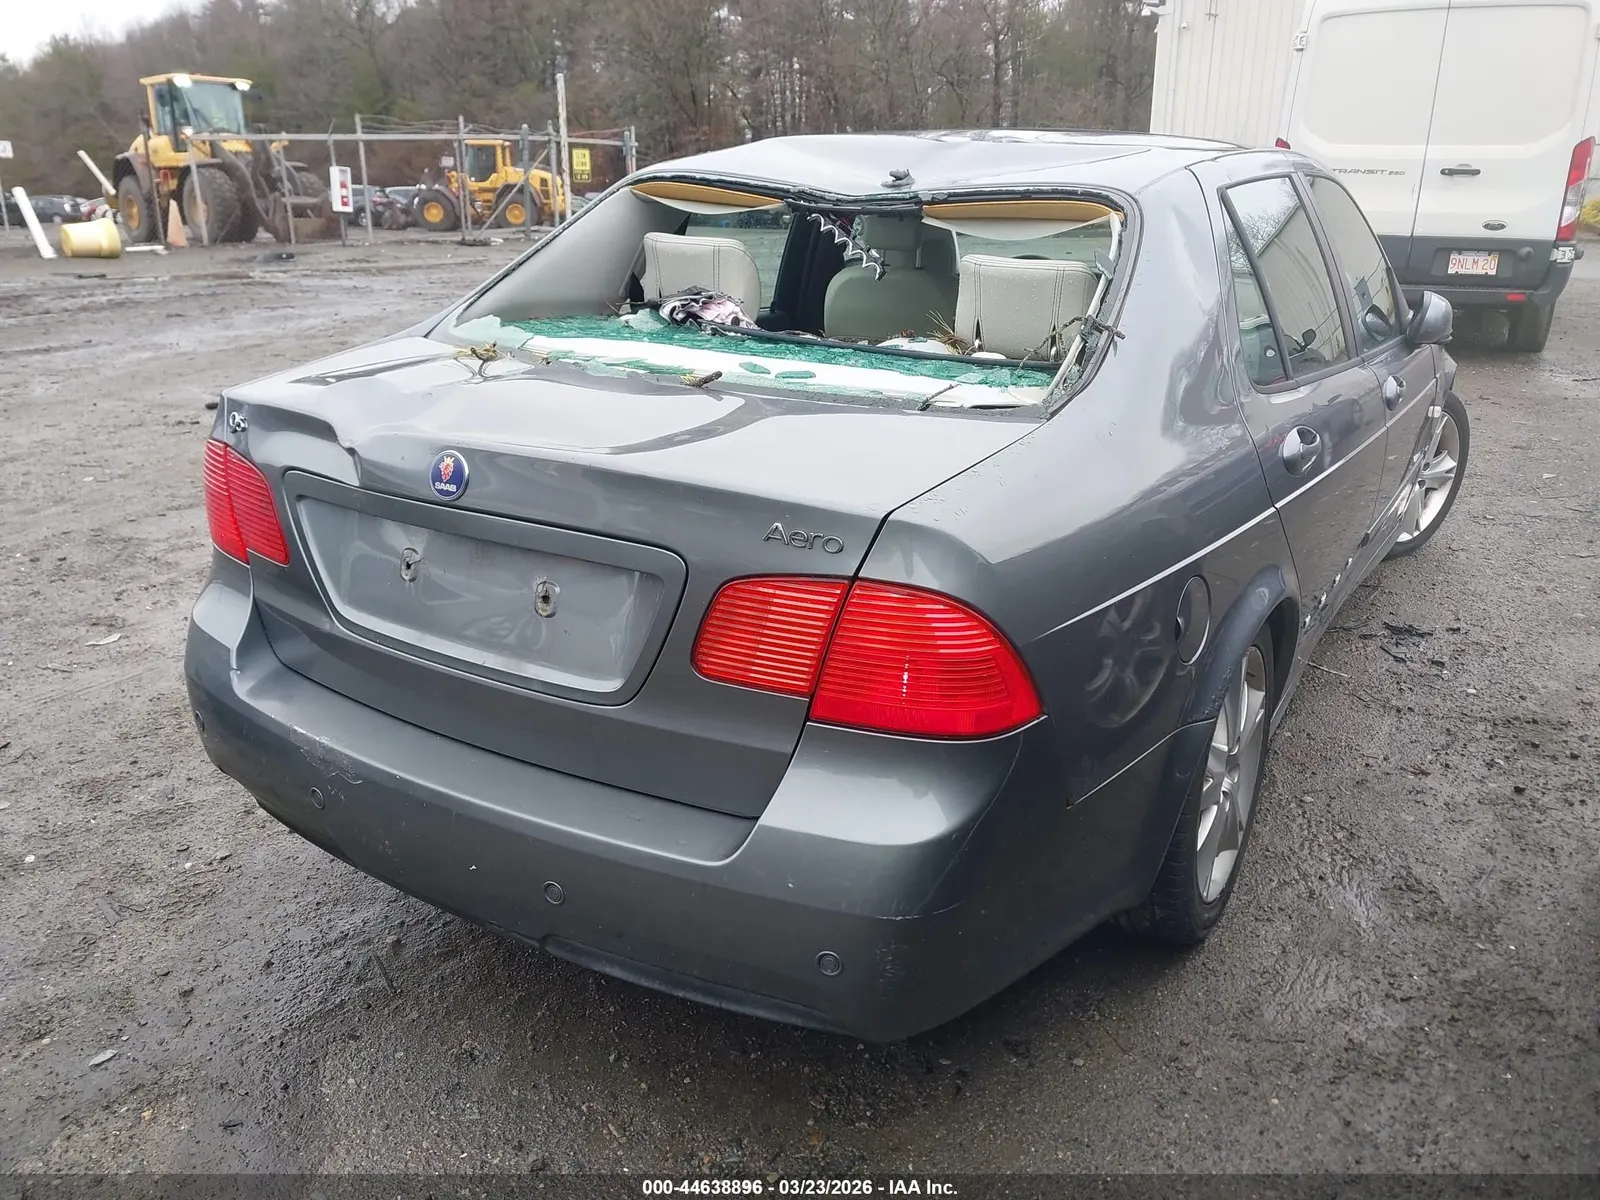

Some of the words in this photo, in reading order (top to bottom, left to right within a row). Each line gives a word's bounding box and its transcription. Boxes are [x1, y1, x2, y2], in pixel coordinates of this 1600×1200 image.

[1450, 257, 1479, 270] 9NLM
[1481, 258, 1497, 271] 20
[434, 481, 457, 492] SAAB
[761, 522, 845, 554] Aero
